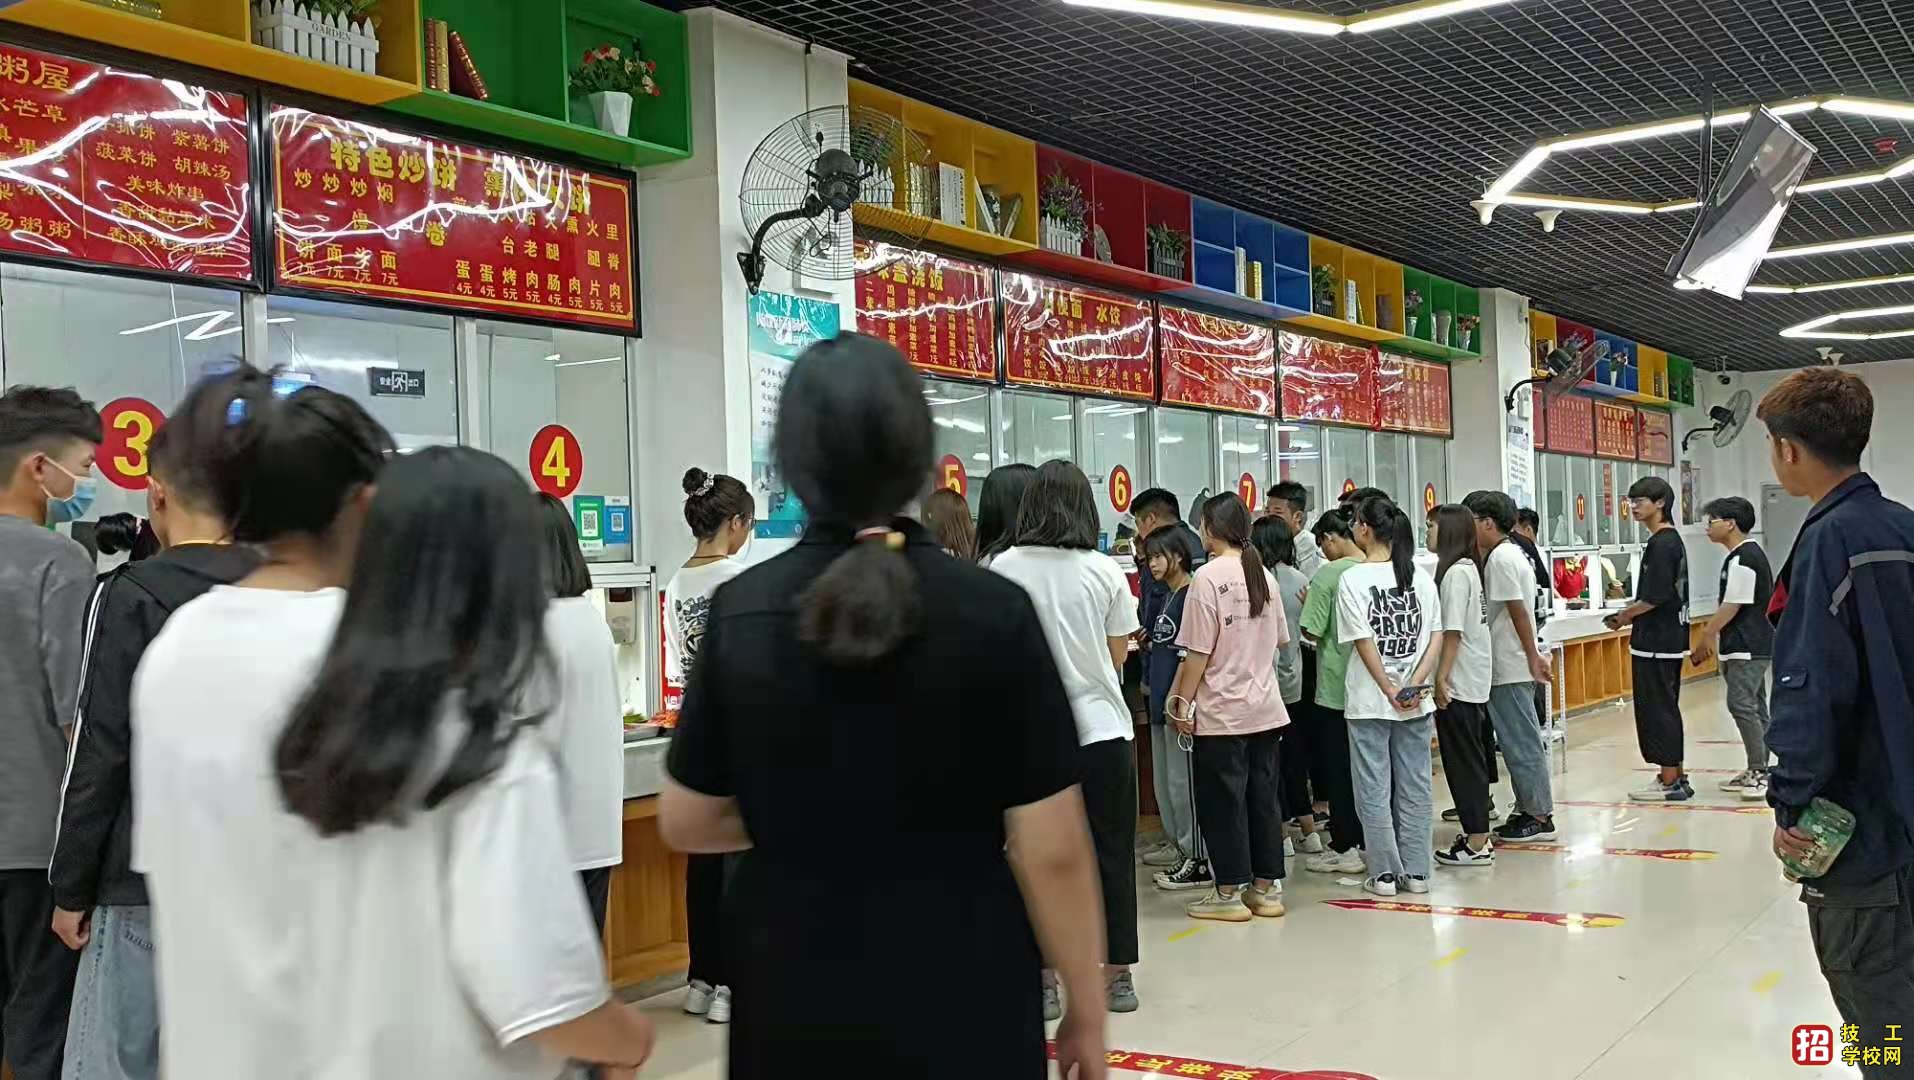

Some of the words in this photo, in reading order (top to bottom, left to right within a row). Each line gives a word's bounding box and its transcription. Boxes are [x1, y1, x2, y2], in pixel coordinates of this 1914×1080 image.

[311, 22, 352, 41] GARDEN
[96, 141, 157, 168] 菠菜饼
[172, 156, 231, 180] 胡辣汤
[330, 137, 457, 191] 特色炒饼
[126, 174, 204, 202] 美味炸串
[353, 268, 373, 283] 7元
[381, 271, 399, 286] 7元
[456, 282, 473, 296] 4元
[479, 285, 496, 299] 4元
[502, 288, 519, 301] 5元
[525, 290, 542, 304] 5元
[547, 293, 562, 306] 4元
[568, 296, 583, 309] 5元
[589, 298, 605, 311] 5元
[610, 301, 625, 314] 5元
[1096, 302, 1121, 326] 水饺
[113, 410, 153, 476] 3
[541, 436, 571, 488] 4
[944, 464, 961, 494] 5
[1114, 471, 1127, 507] 6
[1242, 480, 1252, 512] 7
[1426, 487, 1433, 510] 9
[1577, 498, 1584, 516] 11
